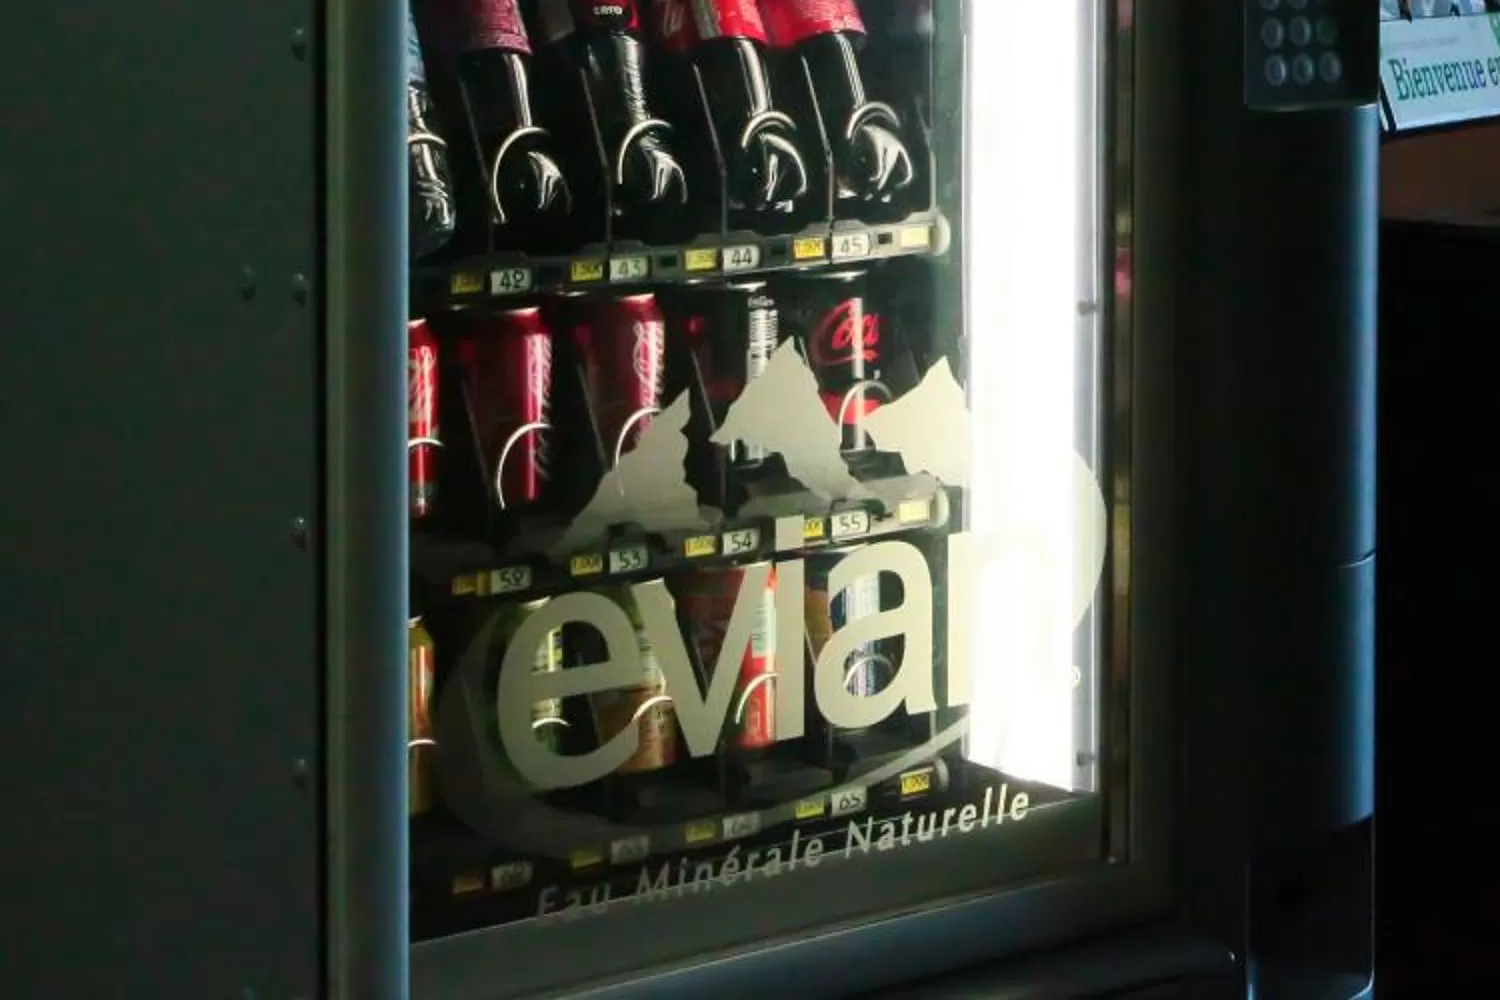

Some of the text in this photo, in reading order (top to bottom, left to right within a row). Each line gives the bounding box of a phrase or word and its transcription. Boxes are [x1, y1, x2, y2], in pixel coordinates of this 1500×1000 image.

[1388, 56, 1487, 101] Bienvenue
[839, 237, 863, 252] 45
[730, 249, 754, 266] 44
[616, 259, 642, 276] 43
[839, 514, 863, 532] 55
[730, 533, 753, 550] 54
[617, 551, 642, 570] 53
[496, 514, 1058, 790] evian
[537, 784, 1031, 922] Eau Minérale Naturelle
